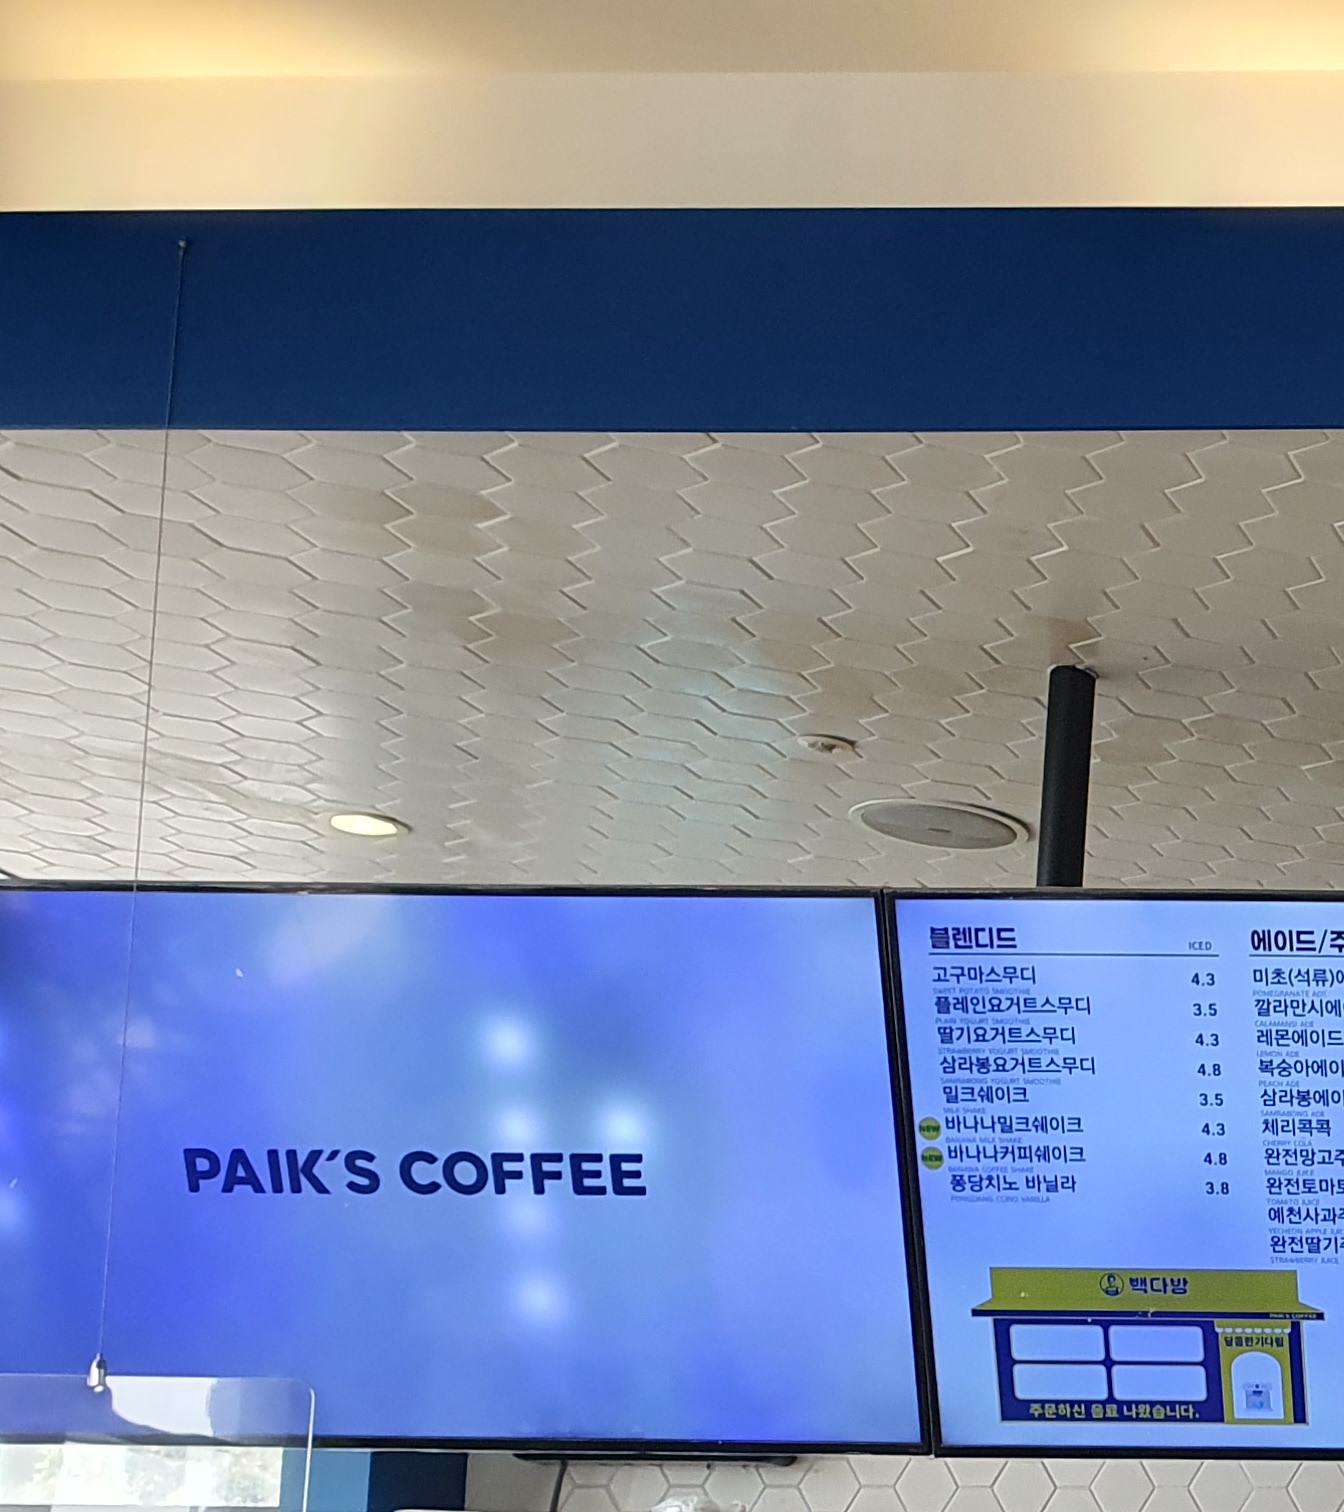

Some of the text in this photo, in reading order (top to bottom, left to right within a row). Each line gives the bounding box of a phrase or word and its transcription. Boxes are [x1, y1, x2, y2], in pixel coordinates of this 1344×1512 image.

[930, 927, 1017, 949] 블렌디드
[1189, 941, 1212, 951] ICED
[932, 966, 1036, 984] 고구마스무디
[1191, 972, 1215, 986] 4.3
[935, 996, 1091, 1014] 플레인요거트스무디
[1193, 1003, 1217, 1016] 3.5
[937, 1027, 1076, 1045] 딸기요거트스무디
[1195, 1033, 1219, 1047] 4.3
[1257, 1029, 1344, 1047] 레몬에이드
[940, 1057, 1096, 1074] 삼라봉요거트스무디
[1197, 1063, 1221, 1077] 4.8
[943, 1087, 1029, 1104] 밀크쉐이크
[1199, 1093, 1223, 1107] 3.5
[945, 1116, 1083, 1134] 바나나밀크쉐이크
[1202, 1123, 1225, 1136] 4.3
[1262, 1119, 1332, 1137] 체리콕콕
[948, 1146, 1086, 1163] 바나나커피쉐이크
[1204, 1152, 1227, 1166] 4.8
[183, 1148, 646, 1196] PAIK'S COFFEE
[950, 1175, 1076, 1193] 퐁당치노 바닐라
[1205, 1182, 1229, 1195] 3.8
[1029, 1404, 1086, 1418] 주문하신
[1123, 1404, 1199, 1419] 나왔습니다.
